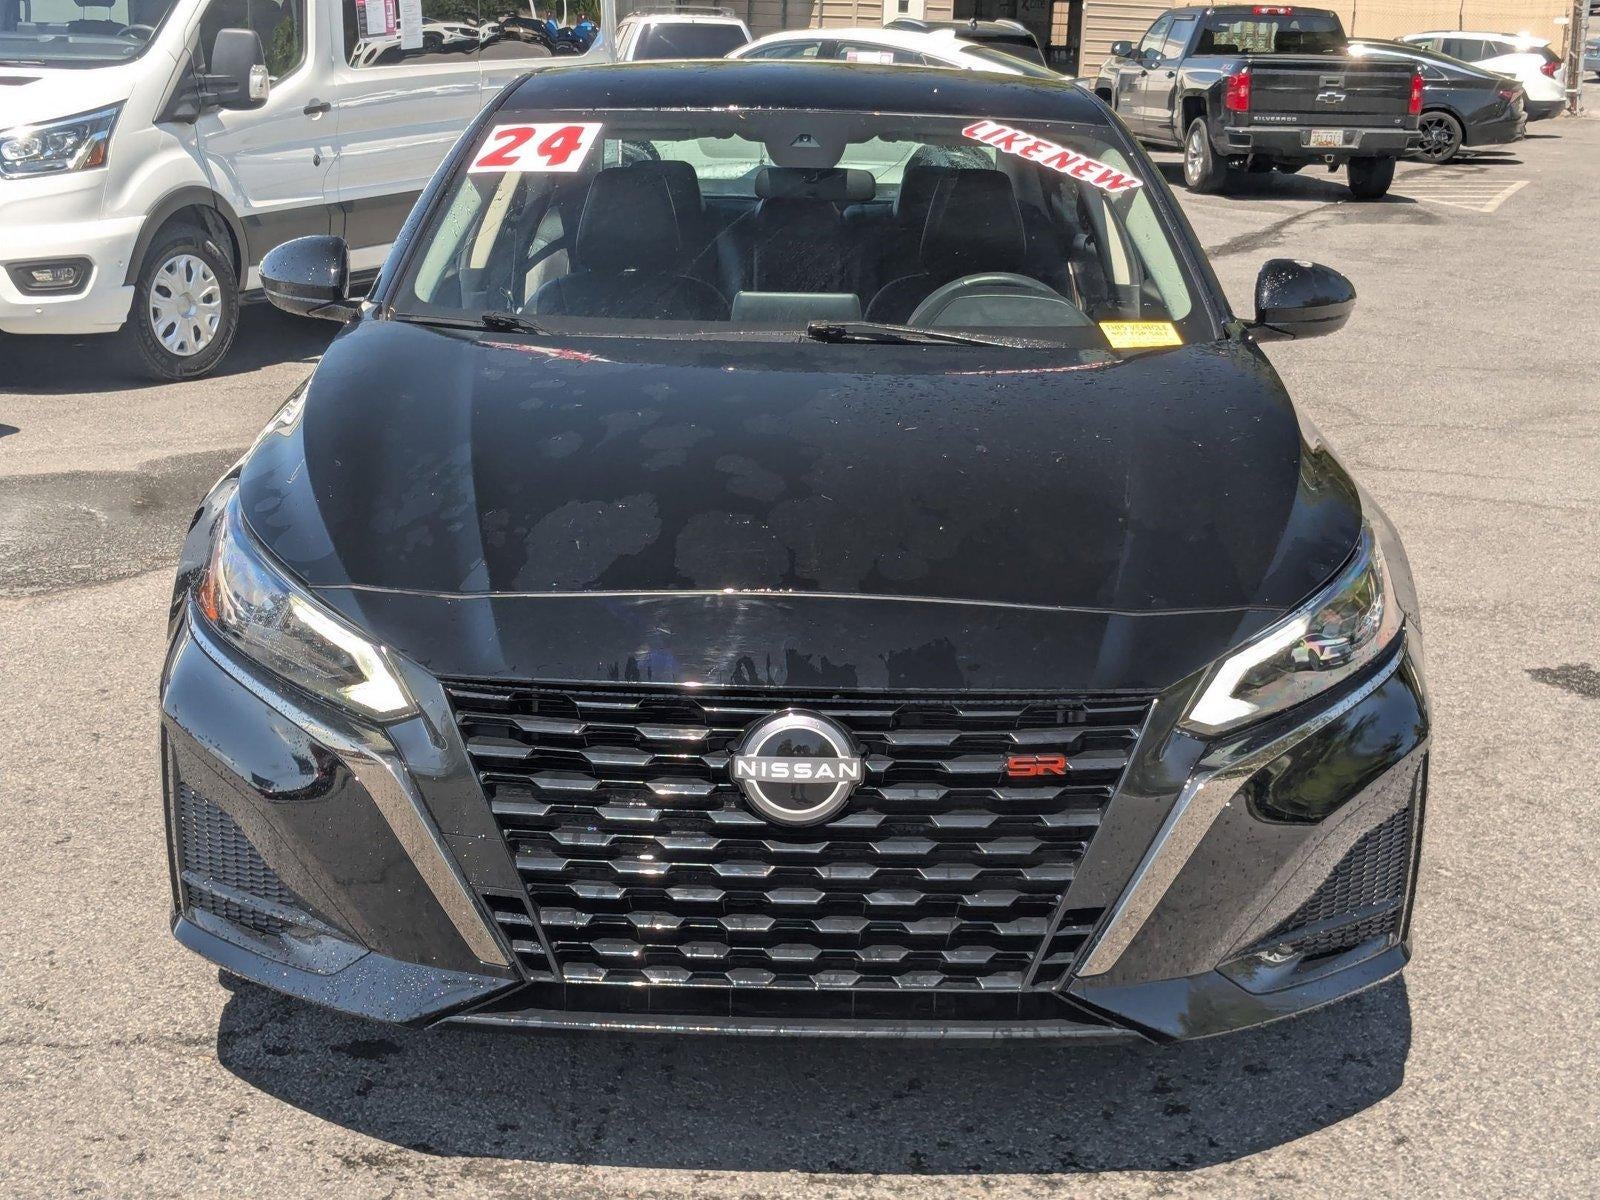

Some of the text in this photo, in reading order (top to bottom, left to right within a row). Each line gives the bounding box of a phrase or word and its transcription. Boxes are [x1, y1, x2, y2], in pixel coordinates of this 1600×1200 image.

[477, 126, 584, 166] 24
[737, 759, 858, 779] NISSAN
[1007, 754, 1067, 776] SR
